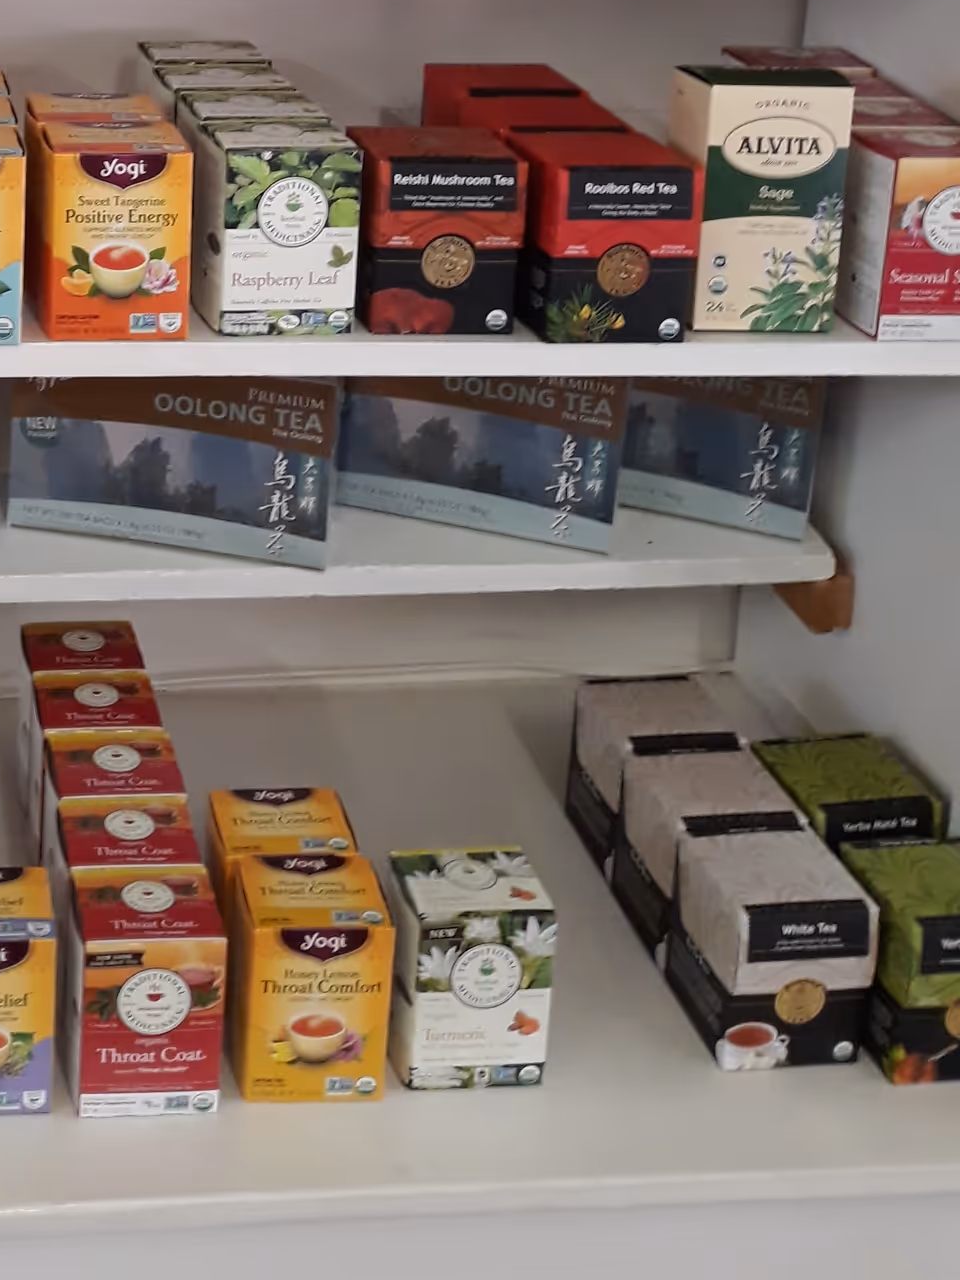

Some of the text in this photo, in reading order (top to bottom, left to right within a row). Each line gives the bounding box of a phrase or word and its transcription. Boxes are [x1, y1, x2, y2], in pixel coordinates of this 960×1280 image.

[736, 136, 822, 157] ALVITA
[393, 173, 515, 186] Reishi Mushroom Tea
[584, 182, 678, 195] Rooibos Red Tea
[758, 185, 795, 200] Sage
[78, 196, 166, 209] Sweet Tangerine
[65, 209, 178, 227] Positive Energy
[231, 271, 339, 290] Raspberry Leaf
[888, 268, 950, 284] Seasonal
[248, 387, 325, 410] PREMIUM
[444, 377, 612, 417] OOLONG TEA
[761, 382, 809, 403] TEA
[154, 393, 323, 433] OOLONG TEA
[26, 415, 56, 430] NEW
[782, 922, 838, 936] White Tea
[284, 969, 360, 981] Honey Lemon
[261, 978, 382, 993] Throat Comfort
[96, 1047, 202, 1064] Throat Coat
